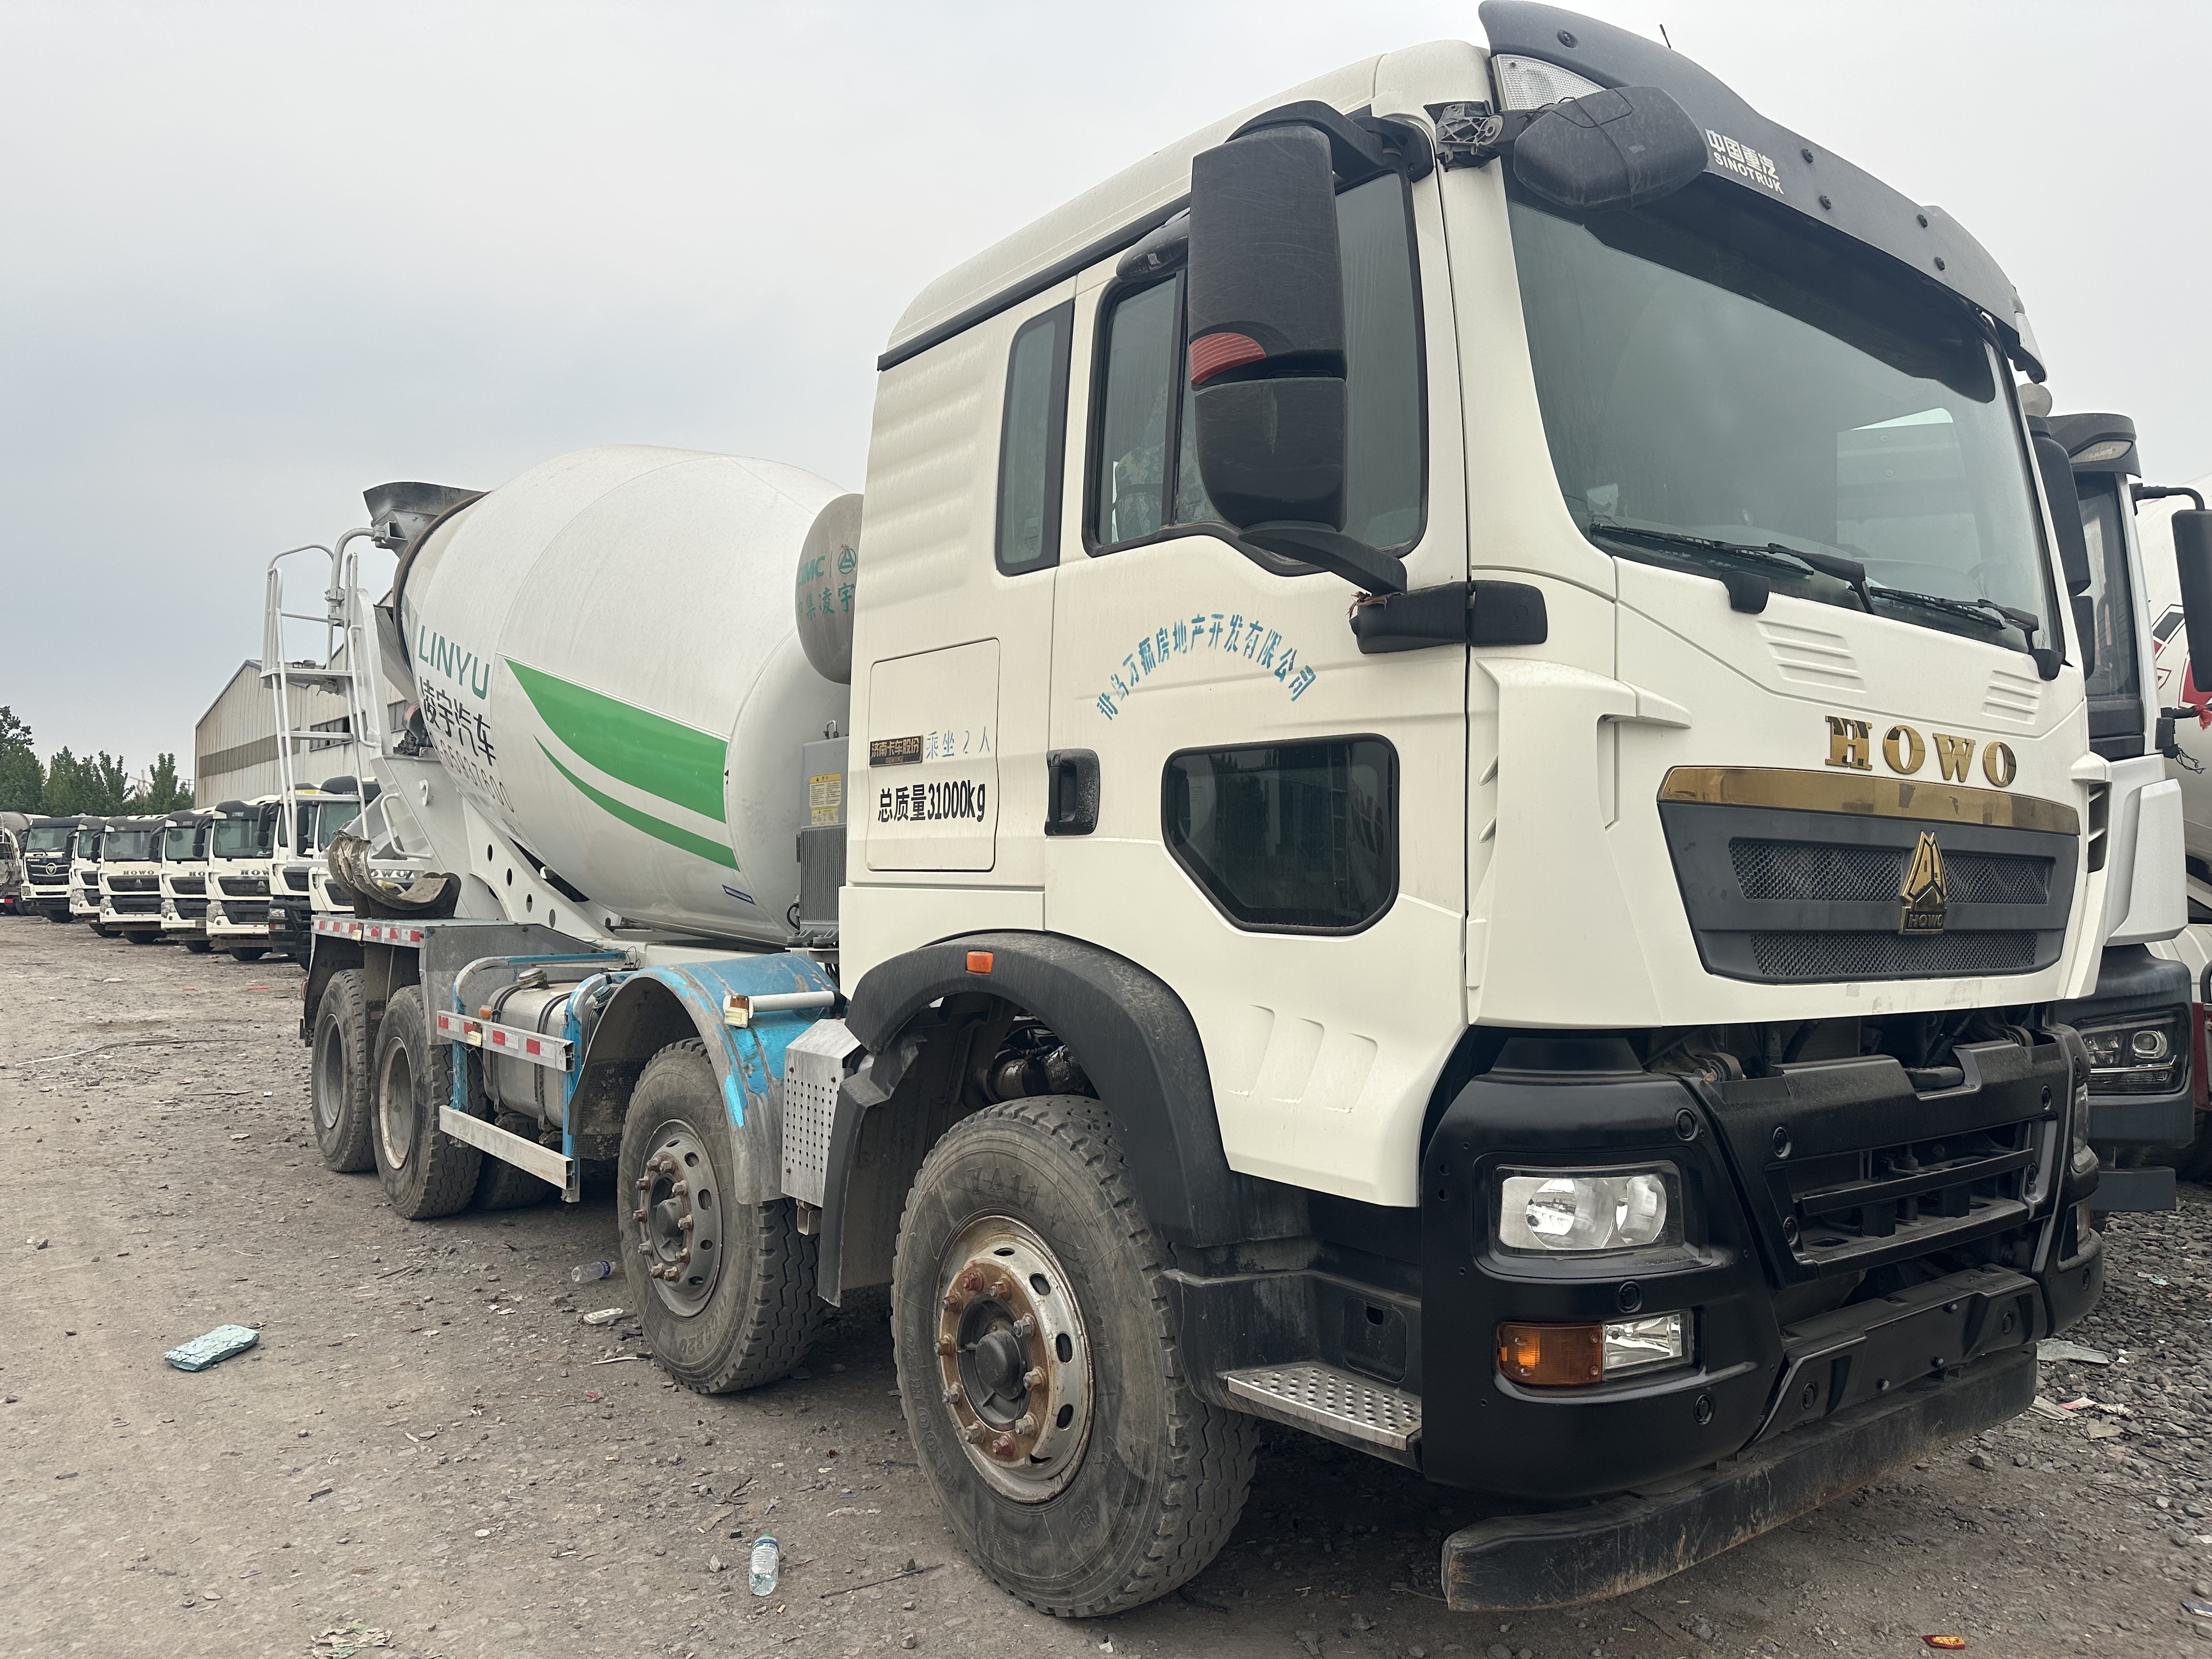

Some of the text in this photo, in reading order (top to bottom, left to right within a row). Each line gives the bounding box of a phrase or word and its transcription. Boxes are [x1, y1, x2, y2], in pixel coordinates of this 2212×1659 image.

[1705, 128, 1779, 180] 中国重汽
[1713, 151, 1784, 195] SINOTRUK
[418, 625, 490, 701] LINYU
[419, 675, 496, 767] 凌宇汽车
[871, 737, 920, 758] 济南卡车股份
[1825, 715, 2017, 788] HOWO
[878, 780, 985, 822] 总质量31000kg
[1908, 914, 1943, 927] HOWO
